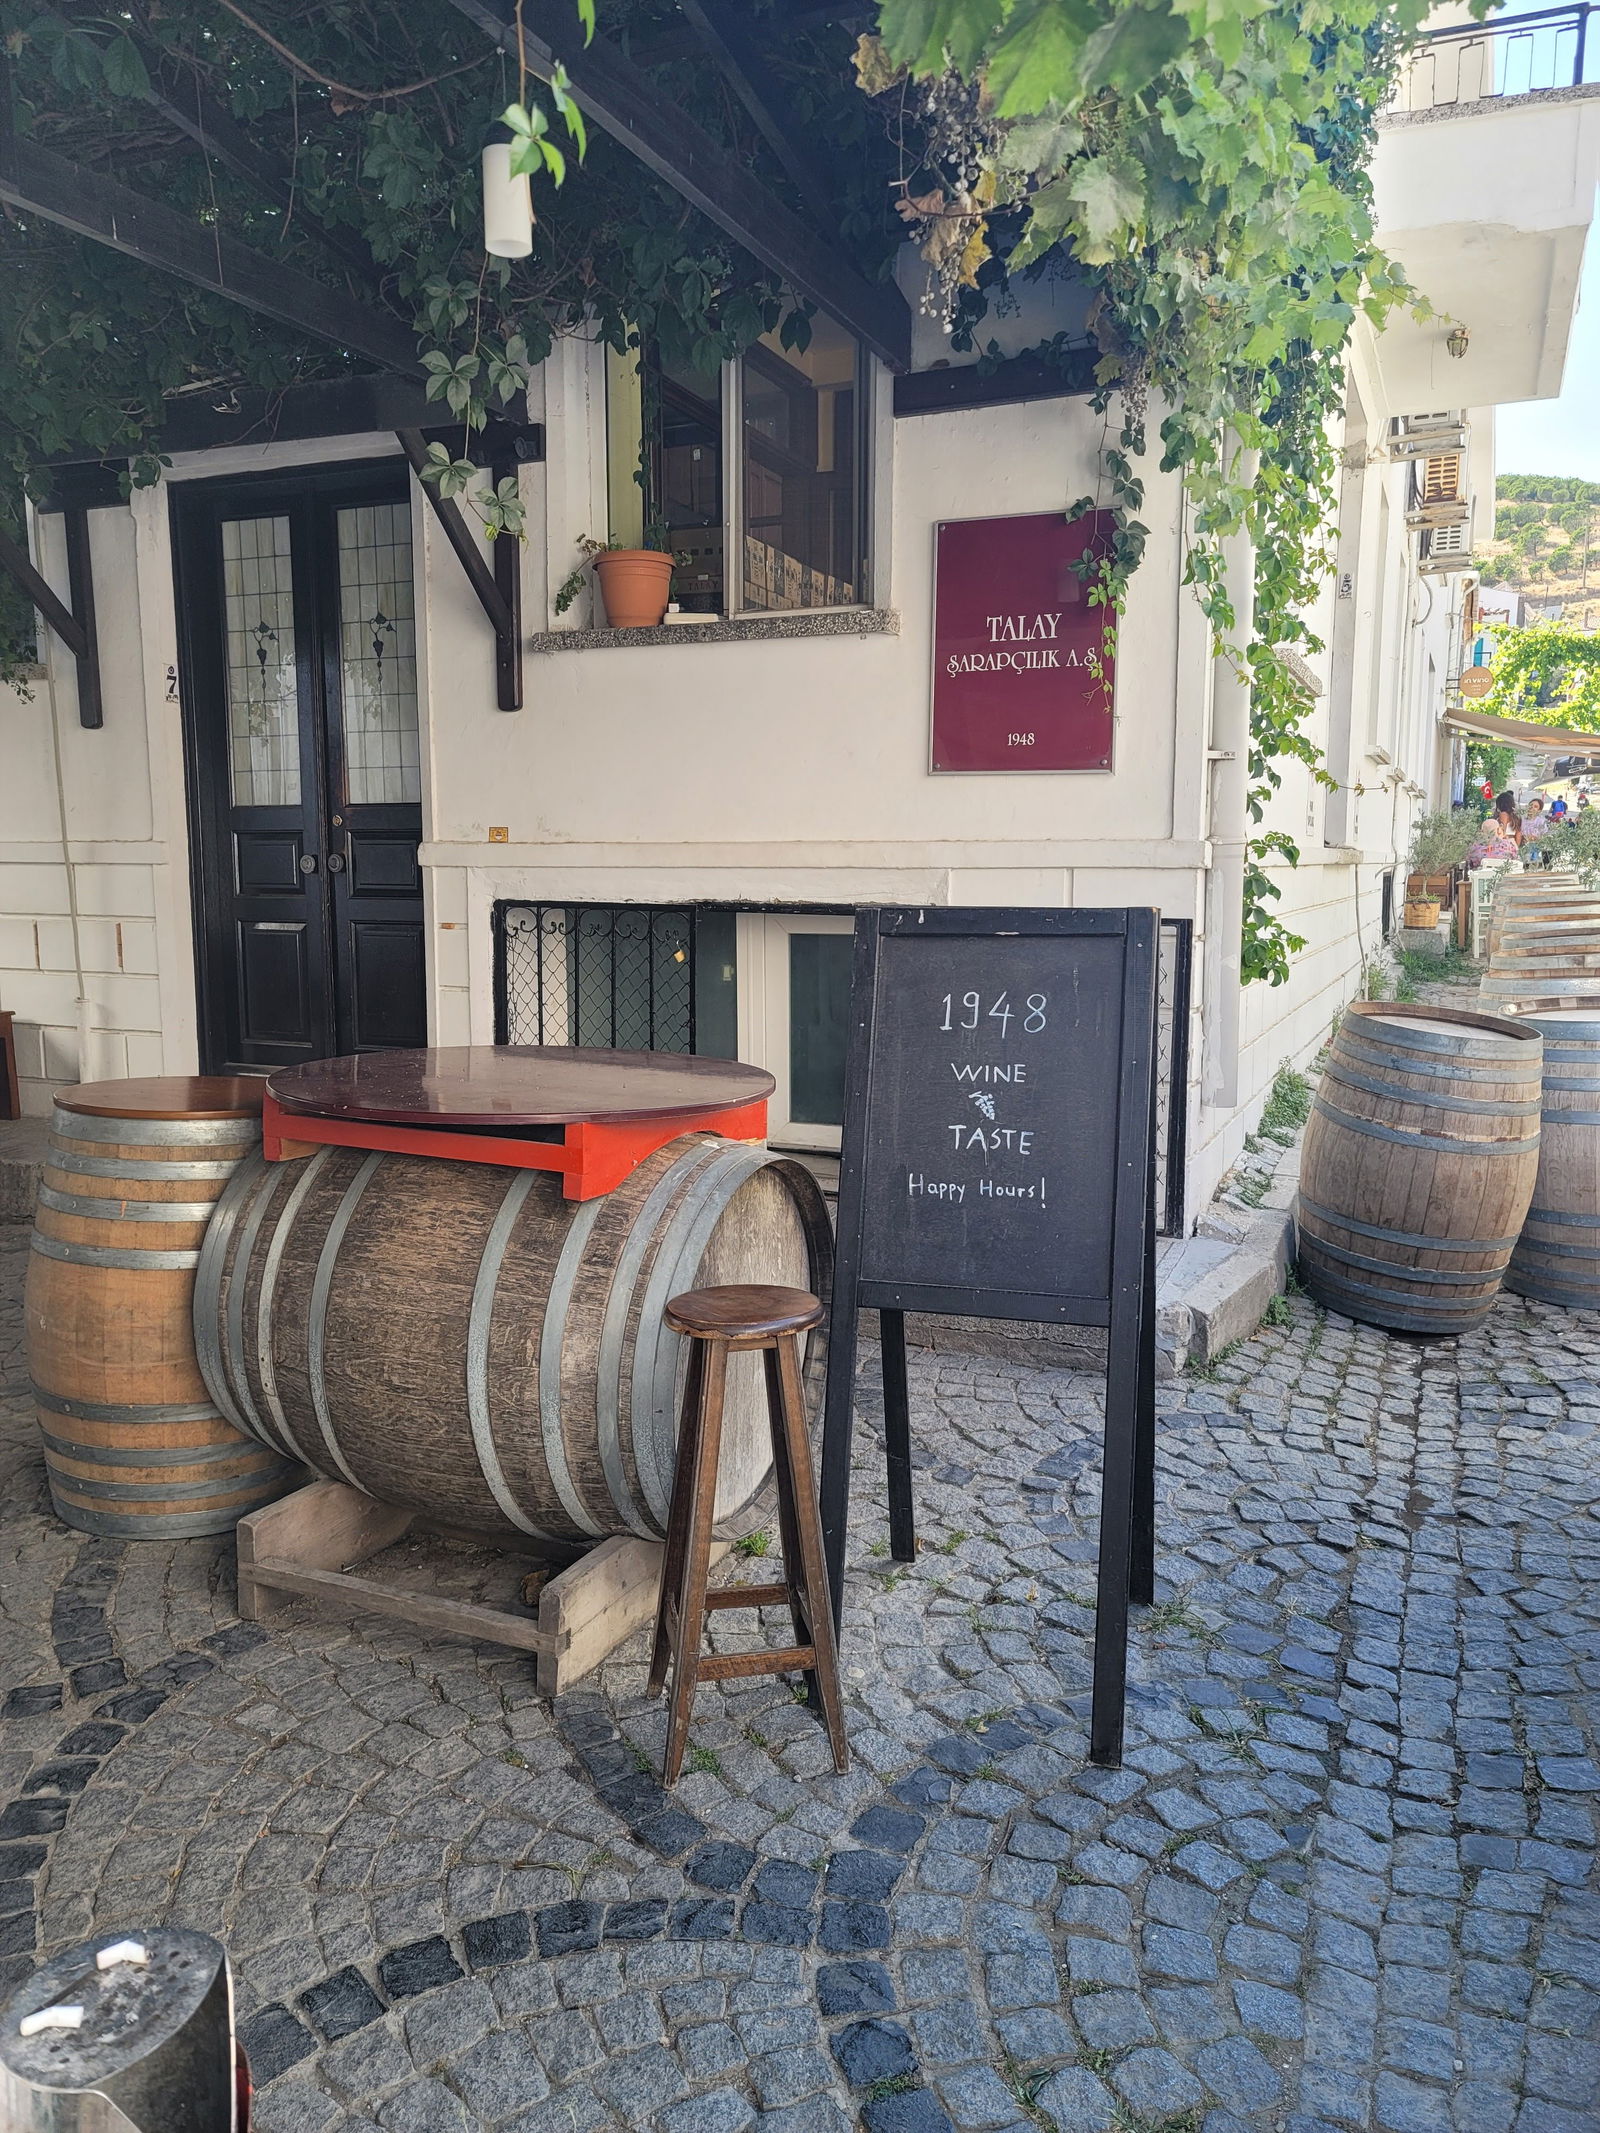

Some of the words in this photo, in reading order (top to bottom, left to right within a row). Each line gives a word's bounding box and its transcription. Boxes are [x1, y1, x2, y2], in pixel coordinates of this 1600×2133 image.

[986, 613, 1062, 642] TALAY
[946, 650, 1059, 677] ŞARAPÇILIK
[167, 675, 177, 694] 7
[1007, 732, 1035, 746] 1948
[939, 991, 1048, 1038] 1948
[951, 1063, 1026, 1083] WINE
[948, 1124, 1034, 1155] TASTE
[908, 1172, 966, 1203] Happy
[980, 1177, 1046, 1209] Hours!
